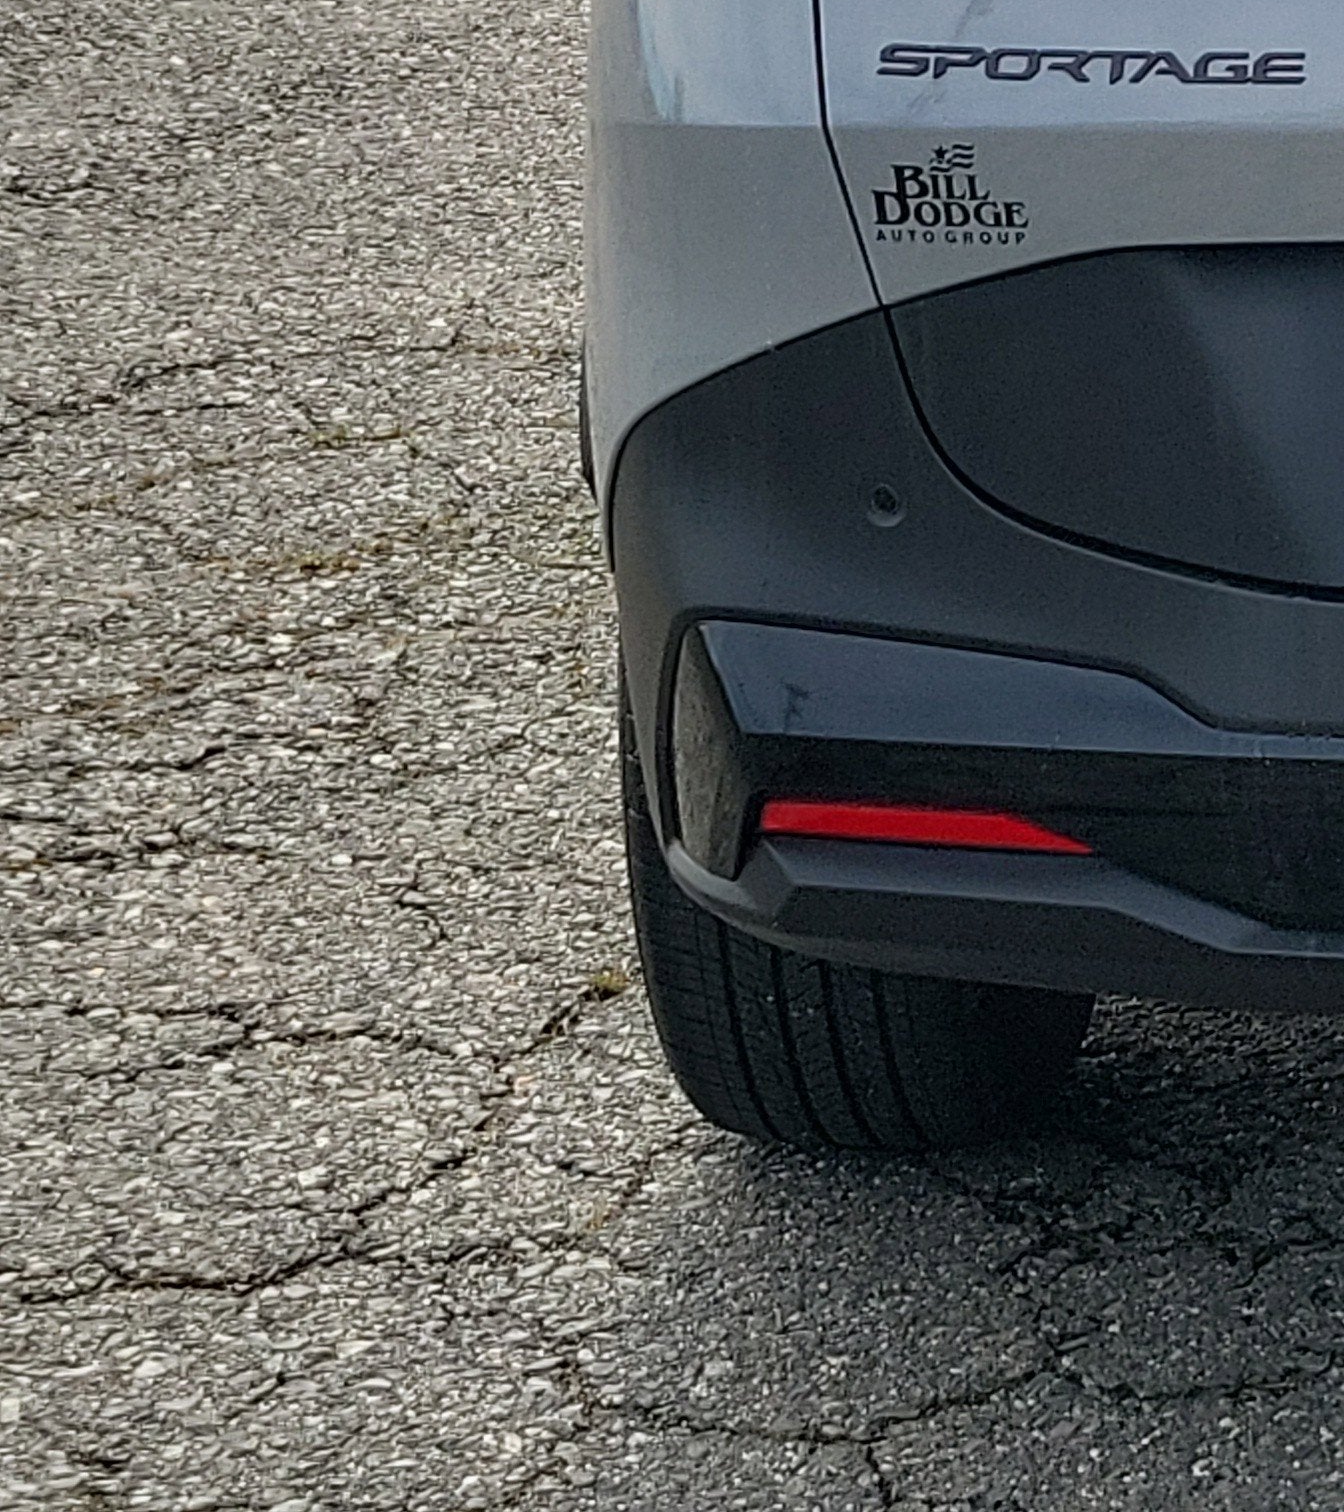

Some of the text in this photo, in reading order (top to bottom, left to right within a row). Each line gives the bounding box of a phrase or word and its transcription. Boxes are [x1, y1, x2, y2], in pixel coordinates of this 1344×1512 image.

[876, 42, 1306, 85] SPORTAGE
[890, 164, 991, 200] BILL
[871, 189, 1029, 228] DODGE
[875, 229, 1026, 245] AUTO GROUP
